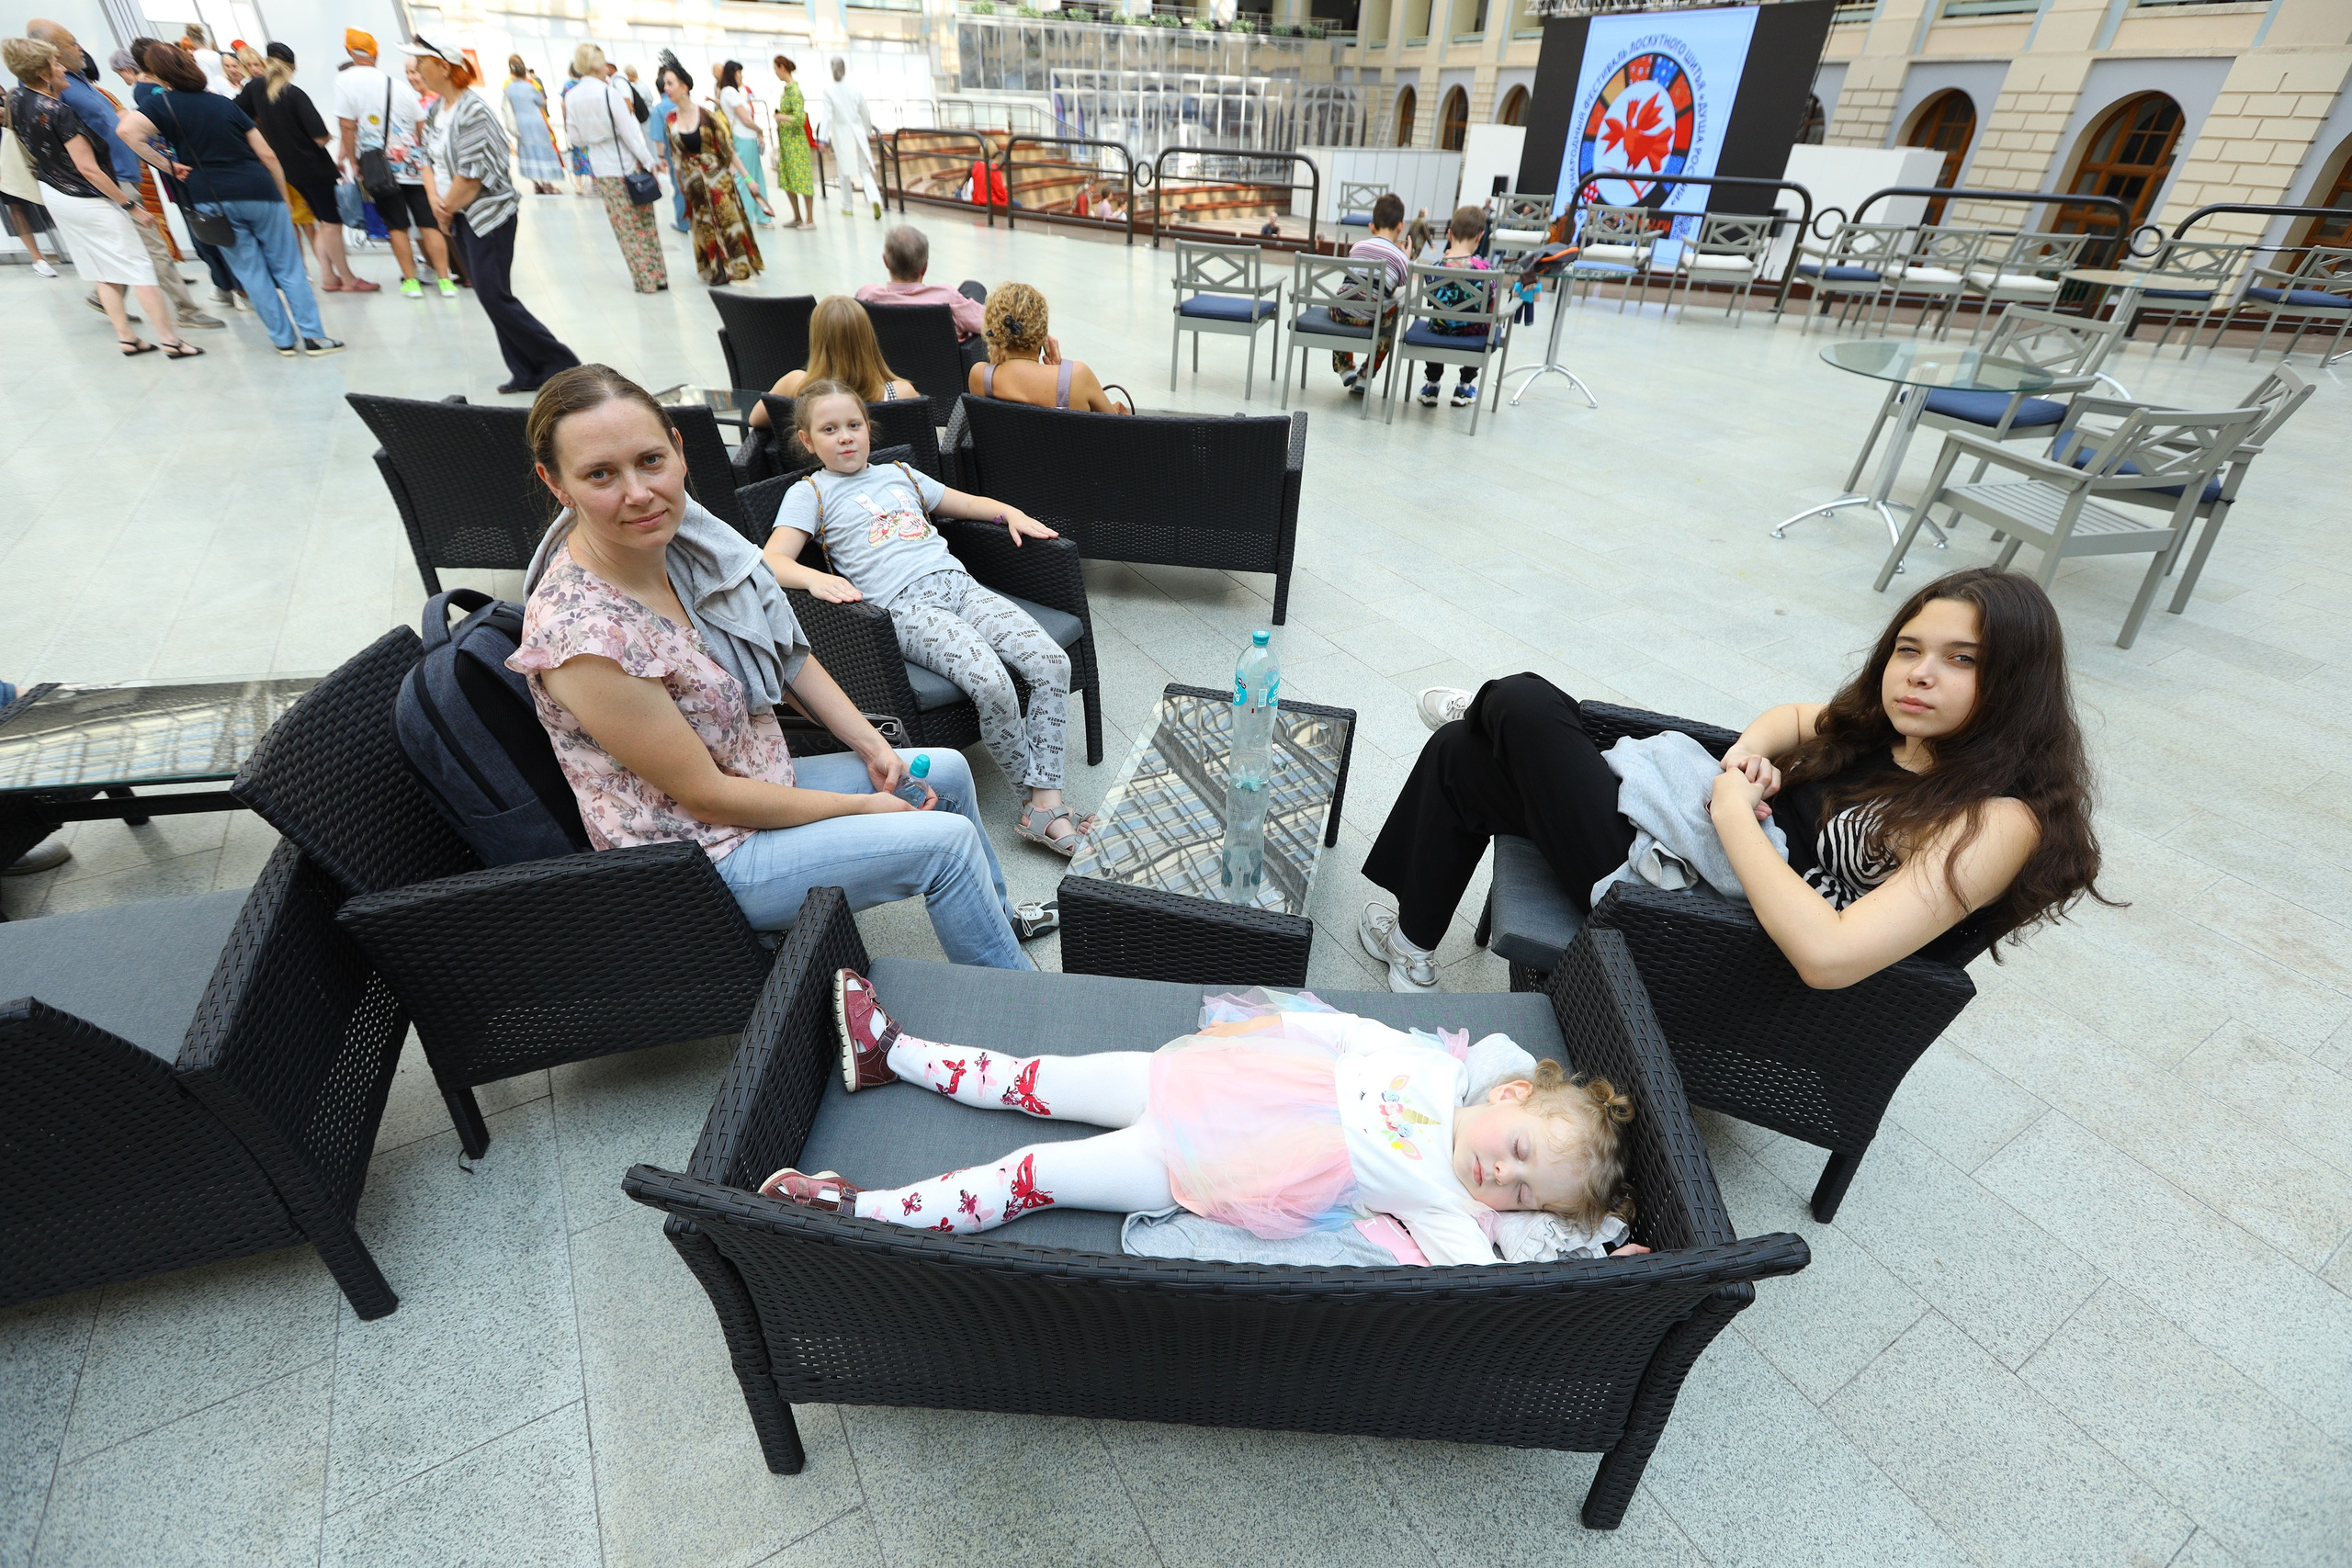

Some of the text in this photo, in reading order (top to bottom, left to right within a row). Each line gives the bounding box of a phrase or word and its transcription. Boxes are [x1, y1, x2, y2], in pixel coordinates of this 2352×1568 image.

[1584, 47, 1627, 108] ФЕСТИВАЛЬ
[1629, 32, 1687, 55] ЛОСКУТНОГО
[1683, 46, 1707, 91] ШИТЬЯ
